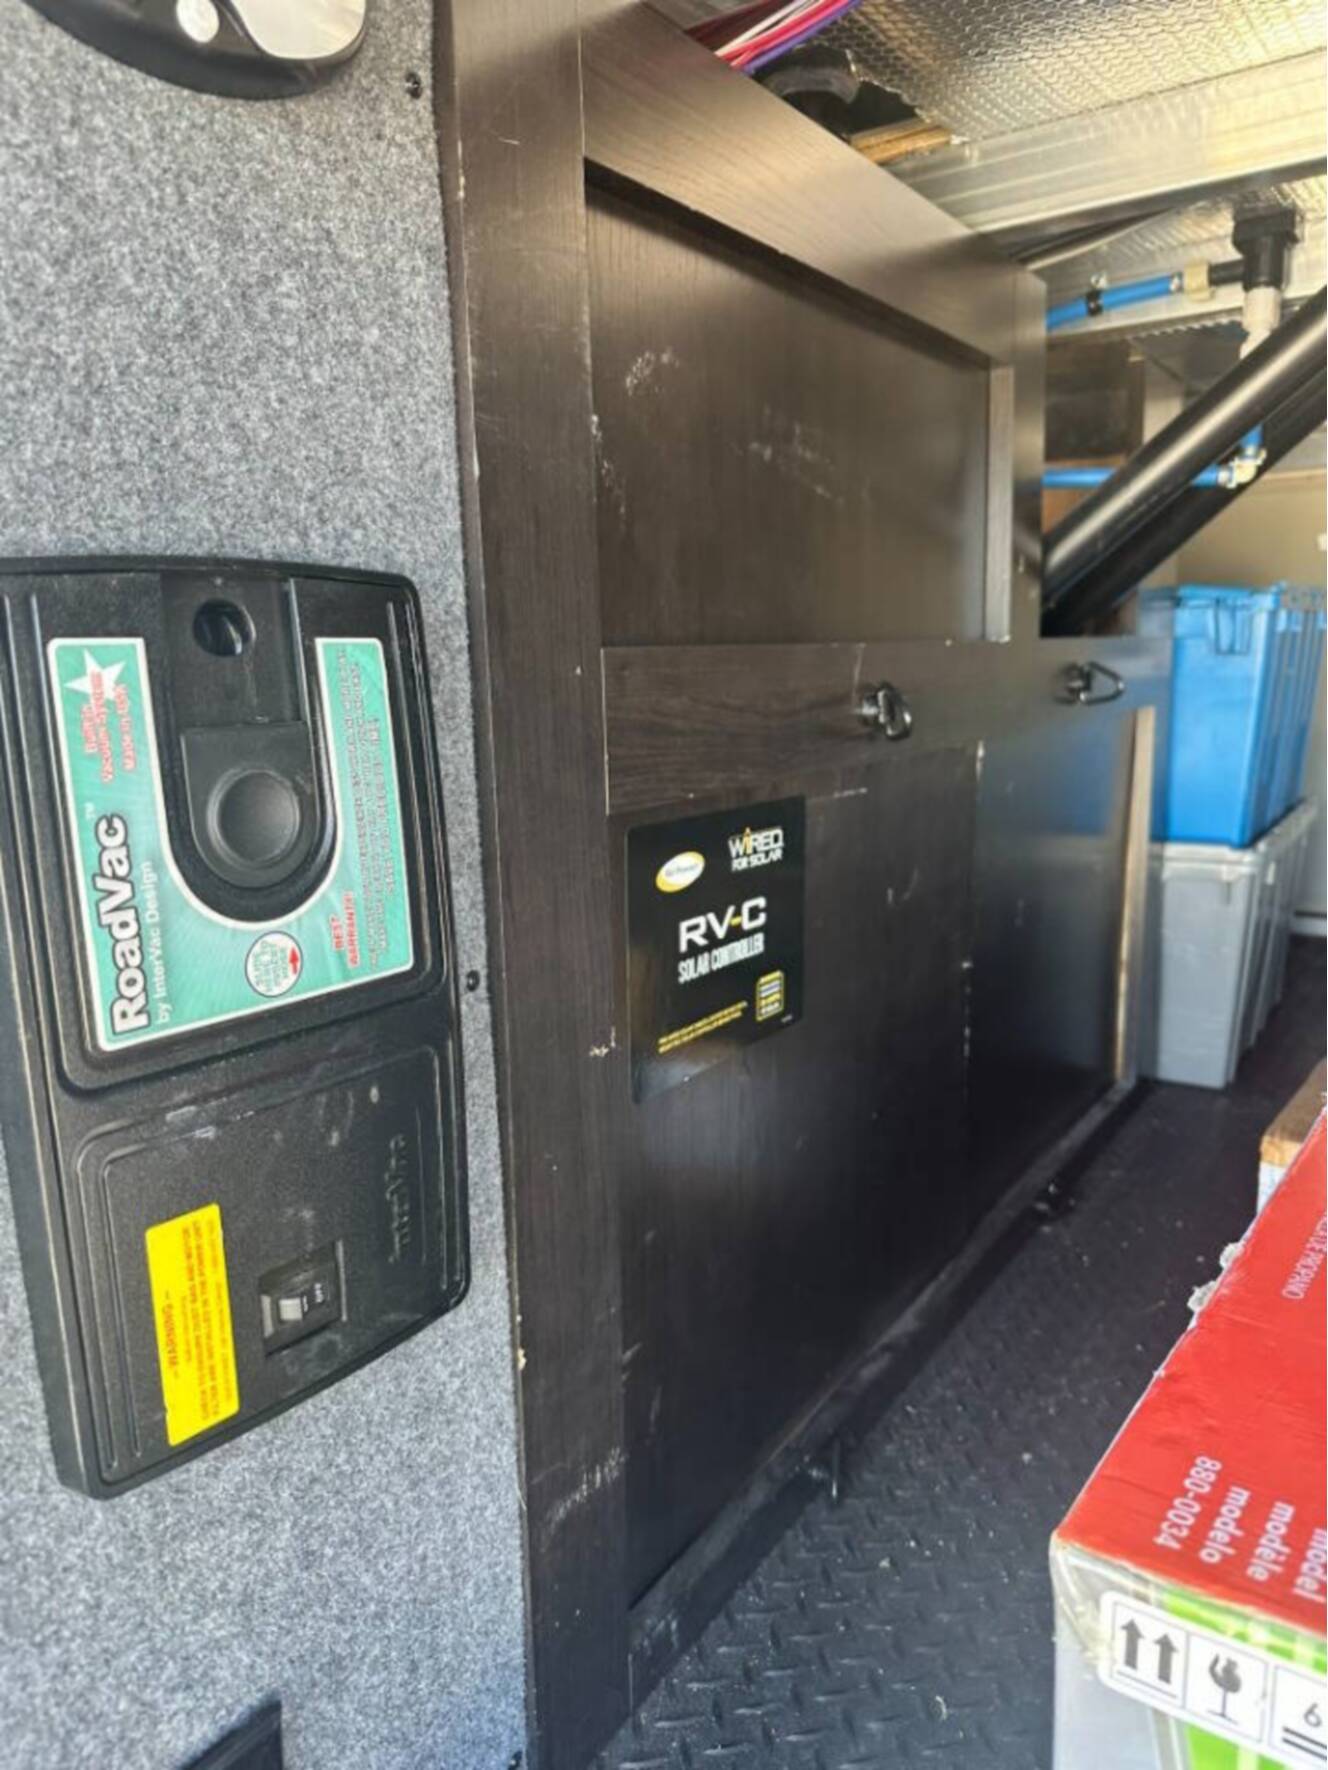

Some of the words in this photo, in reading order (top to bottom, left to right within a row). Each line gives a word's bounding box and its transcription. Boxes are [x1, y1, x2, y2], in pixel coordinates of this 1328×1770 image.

[731, 857, 750, 872] FOR
[750, 847, 783, 868] SOLAR
[141, 861, 161, 924] Design
[92, 813, 150, 1036] RoadVac
[678, 896, 767, 953] RV-C
[148, 926, 169, 998] InterVac
[678, 950, 710, 984] SOLAR
[711, 932, 765, 972] CONTROLLER
[155, 999, 171, 1025] by
[1153, 1455, 1222, 1550] 880-0034
[1199, 1486, 1251, 1565] modelo
[1247, 1501, 1295, 1582] modèle
[1303, 1703, 1323, 1729] 6
